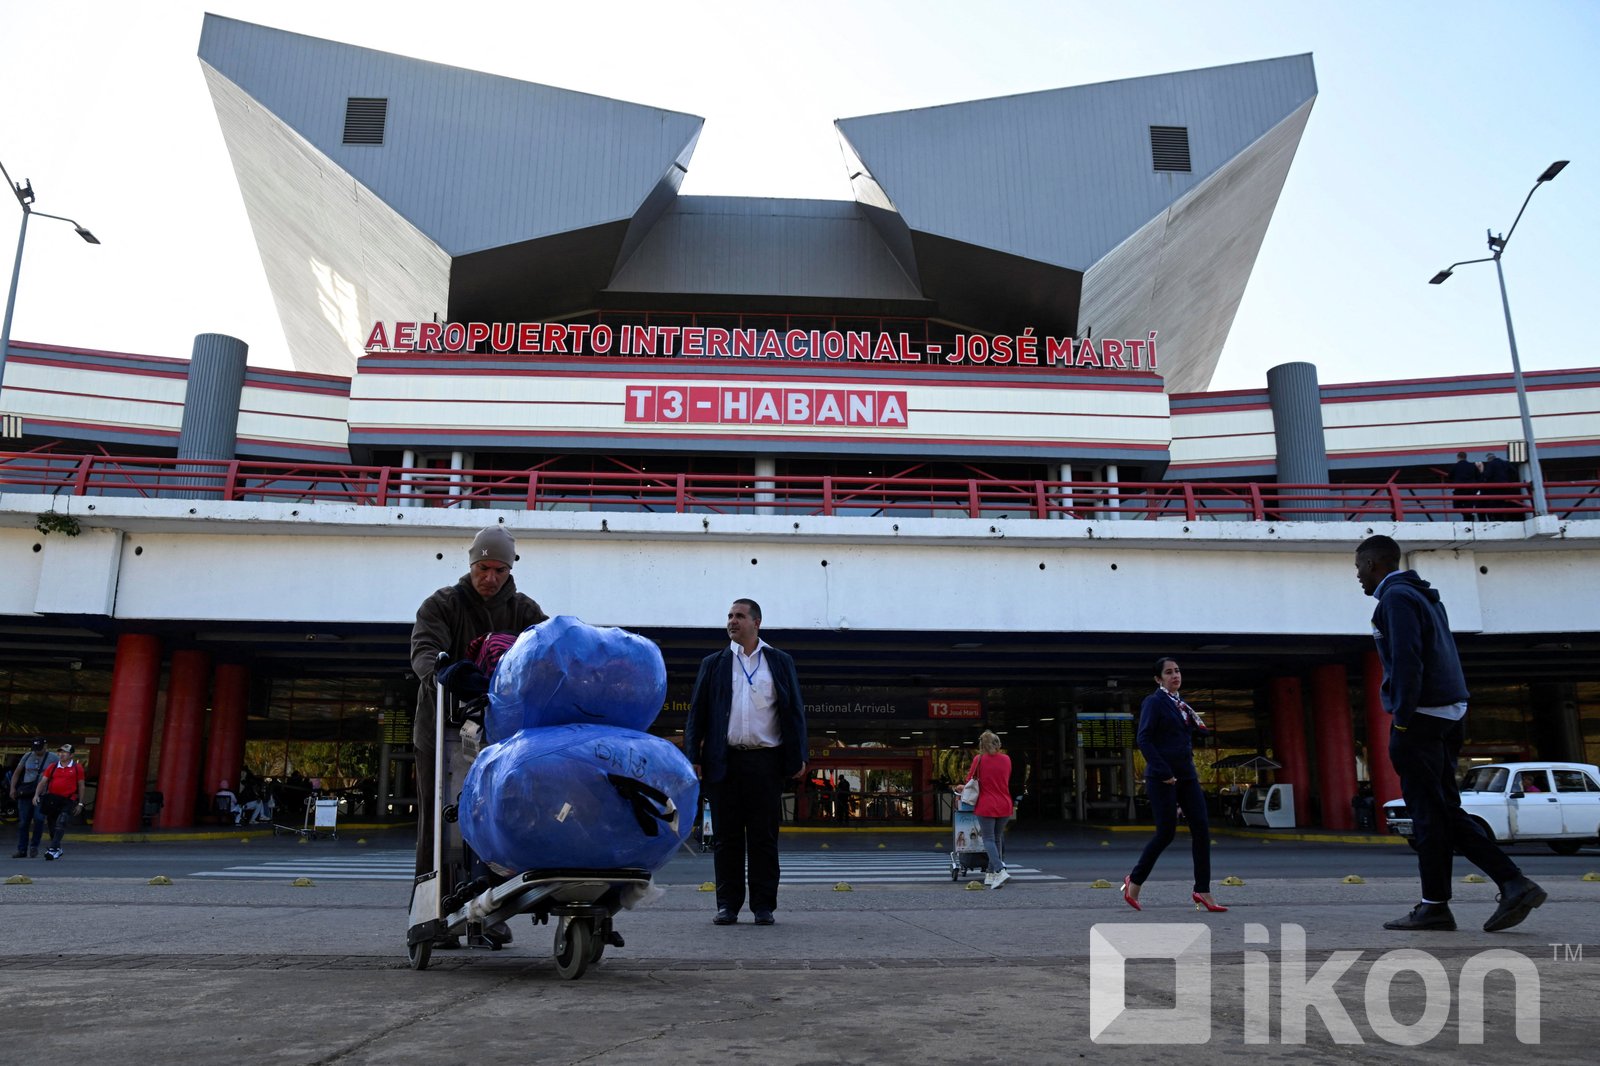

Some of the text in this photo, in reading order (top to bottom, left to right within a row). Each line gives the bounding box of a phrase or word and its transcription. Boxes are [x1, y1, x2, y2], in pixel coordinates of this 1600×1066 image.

[364, 321, 613, 353] AEROPUERTO
[620, 324, 921, 362] INTERNACIONAL
[945, 327, 1038, 365] JOSÉ
[1046, 330, 1158, 369] MARTÍ
[854, 702, 897, 713] Arrivals
[931, 703, 948, 716] T3
